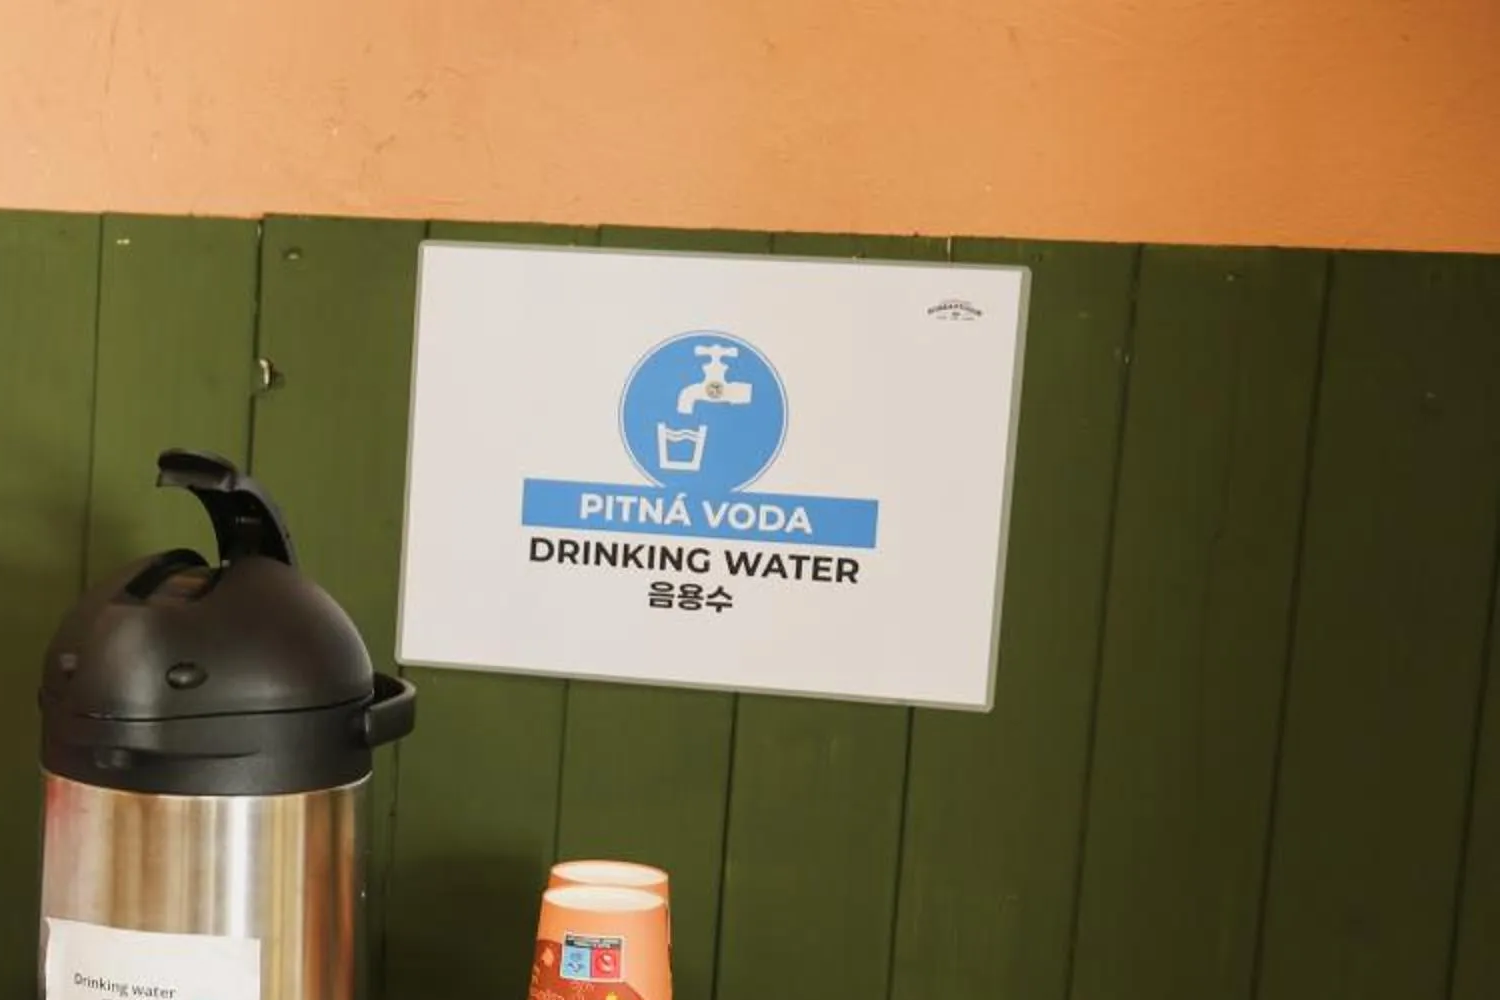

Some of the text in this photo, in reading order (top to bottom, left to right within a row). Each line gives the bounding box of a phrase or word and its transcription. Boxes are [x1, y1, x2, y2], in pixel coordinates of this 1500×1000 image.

[579, 491, 813, 535] PITNÁ VODA
[529, 536, 861, 585] DRINKING WATER
[648, 580, 734, 613] 음용수
[74, 972, 176, 999] Drinking water
